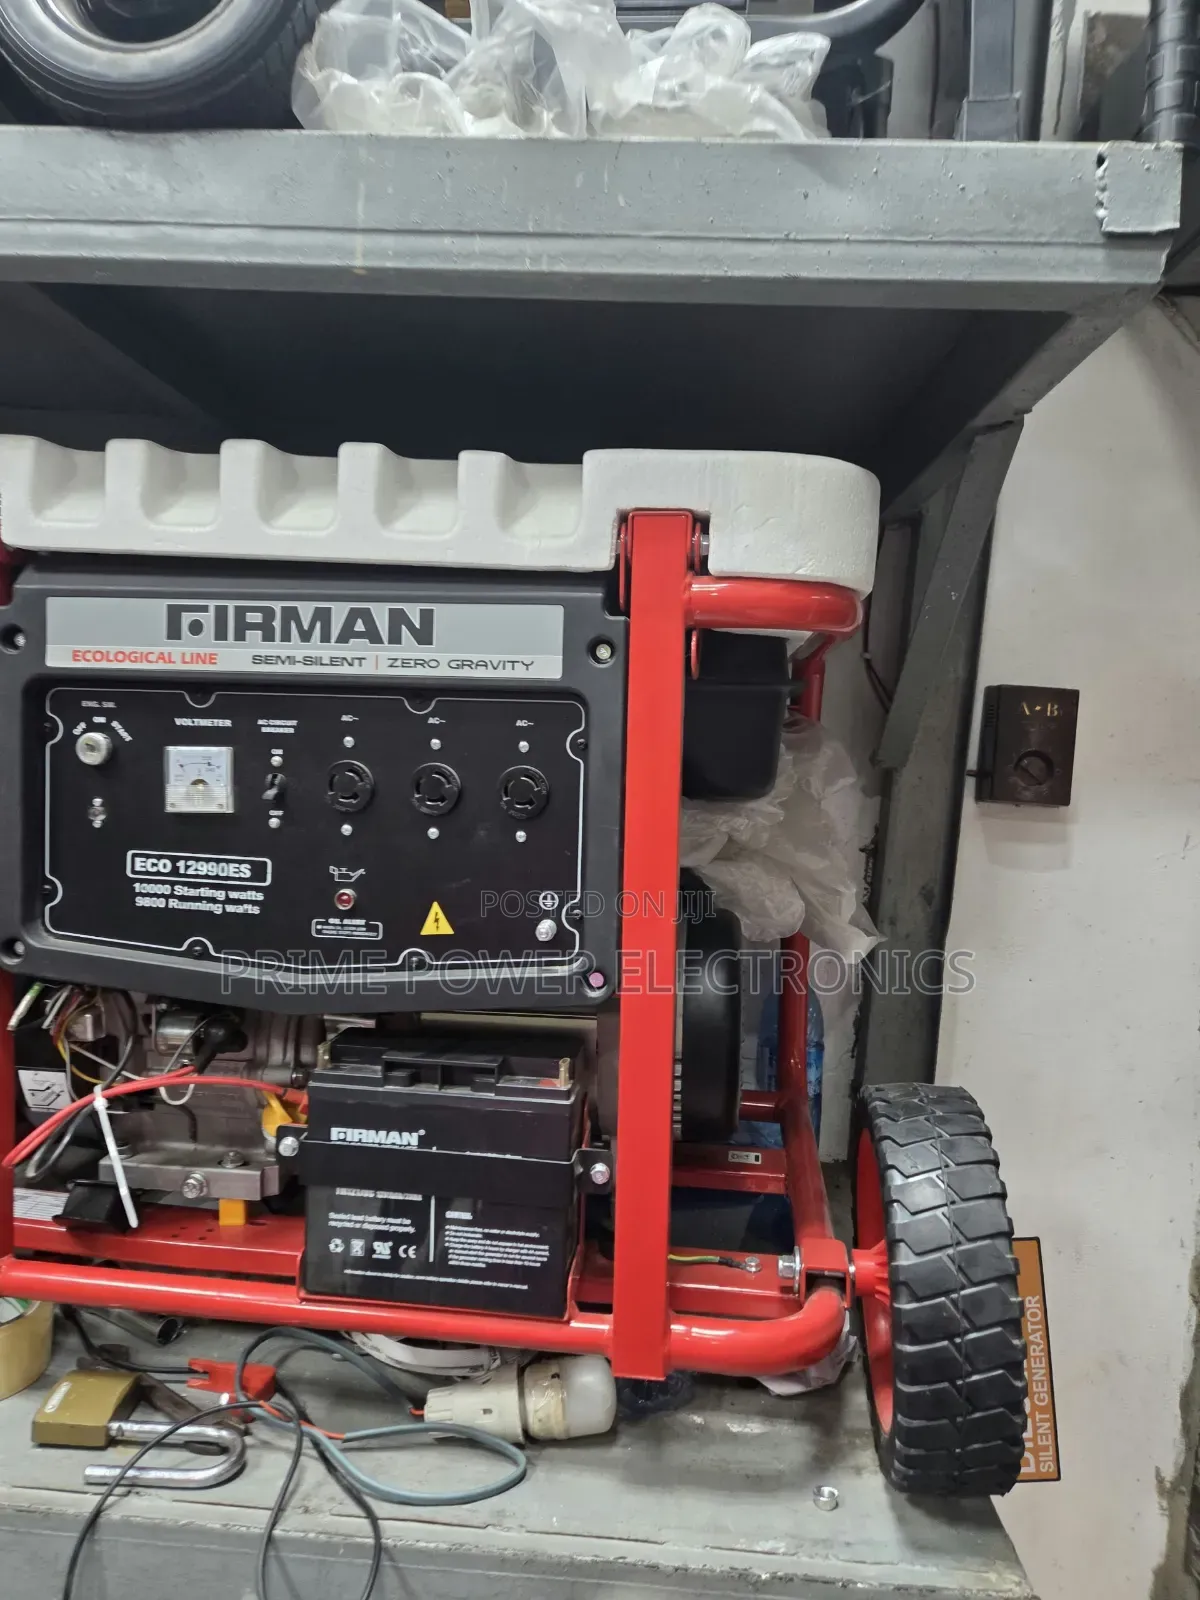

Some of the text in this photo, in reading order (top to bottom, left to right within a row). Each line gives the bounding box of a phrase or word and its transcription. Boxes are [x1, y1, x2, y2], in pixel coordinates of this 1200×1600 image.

[165, 603, 435, 647] FIRMAN
[72, 649, 218, 665] ECOLOGICAL LINE
[252, 653, 367, 668] SEMI-SILENT
[387, 657, 535, 671] ZERO GRAVITY
[174, 717, 232, 727] VOLTMETER
[134, 857, 252, 878] ECO 12990ES
[133, 883, 265, 901] 10000 Starting watts
[135, 896, 261, 915] 9800 Running watts
[330, 1127, 419, 1146] FIRMAN
[1025, 1295, 1055, 1472] SILENT GENERATOR
